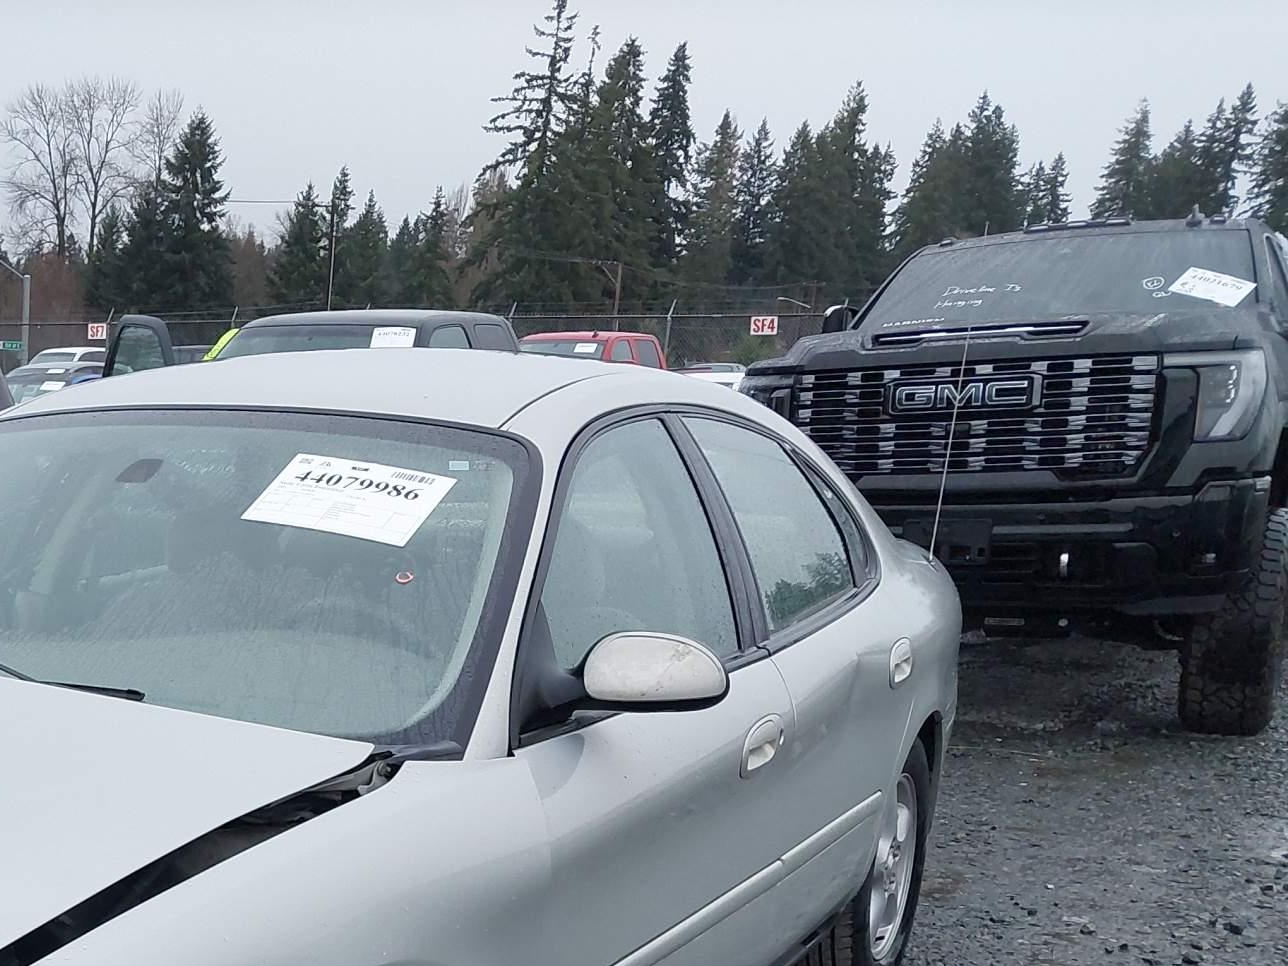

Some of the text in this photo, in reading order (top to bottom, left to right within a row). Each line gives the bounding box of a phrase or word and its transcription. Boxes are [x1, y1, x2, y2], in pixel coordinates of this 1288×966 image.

[89, 325, 105, 338] SF7
[752, 318, 776, 333] SF4
[895, 380, 1029, 410] GMC
[295, 469, 425, 501] 44079986
